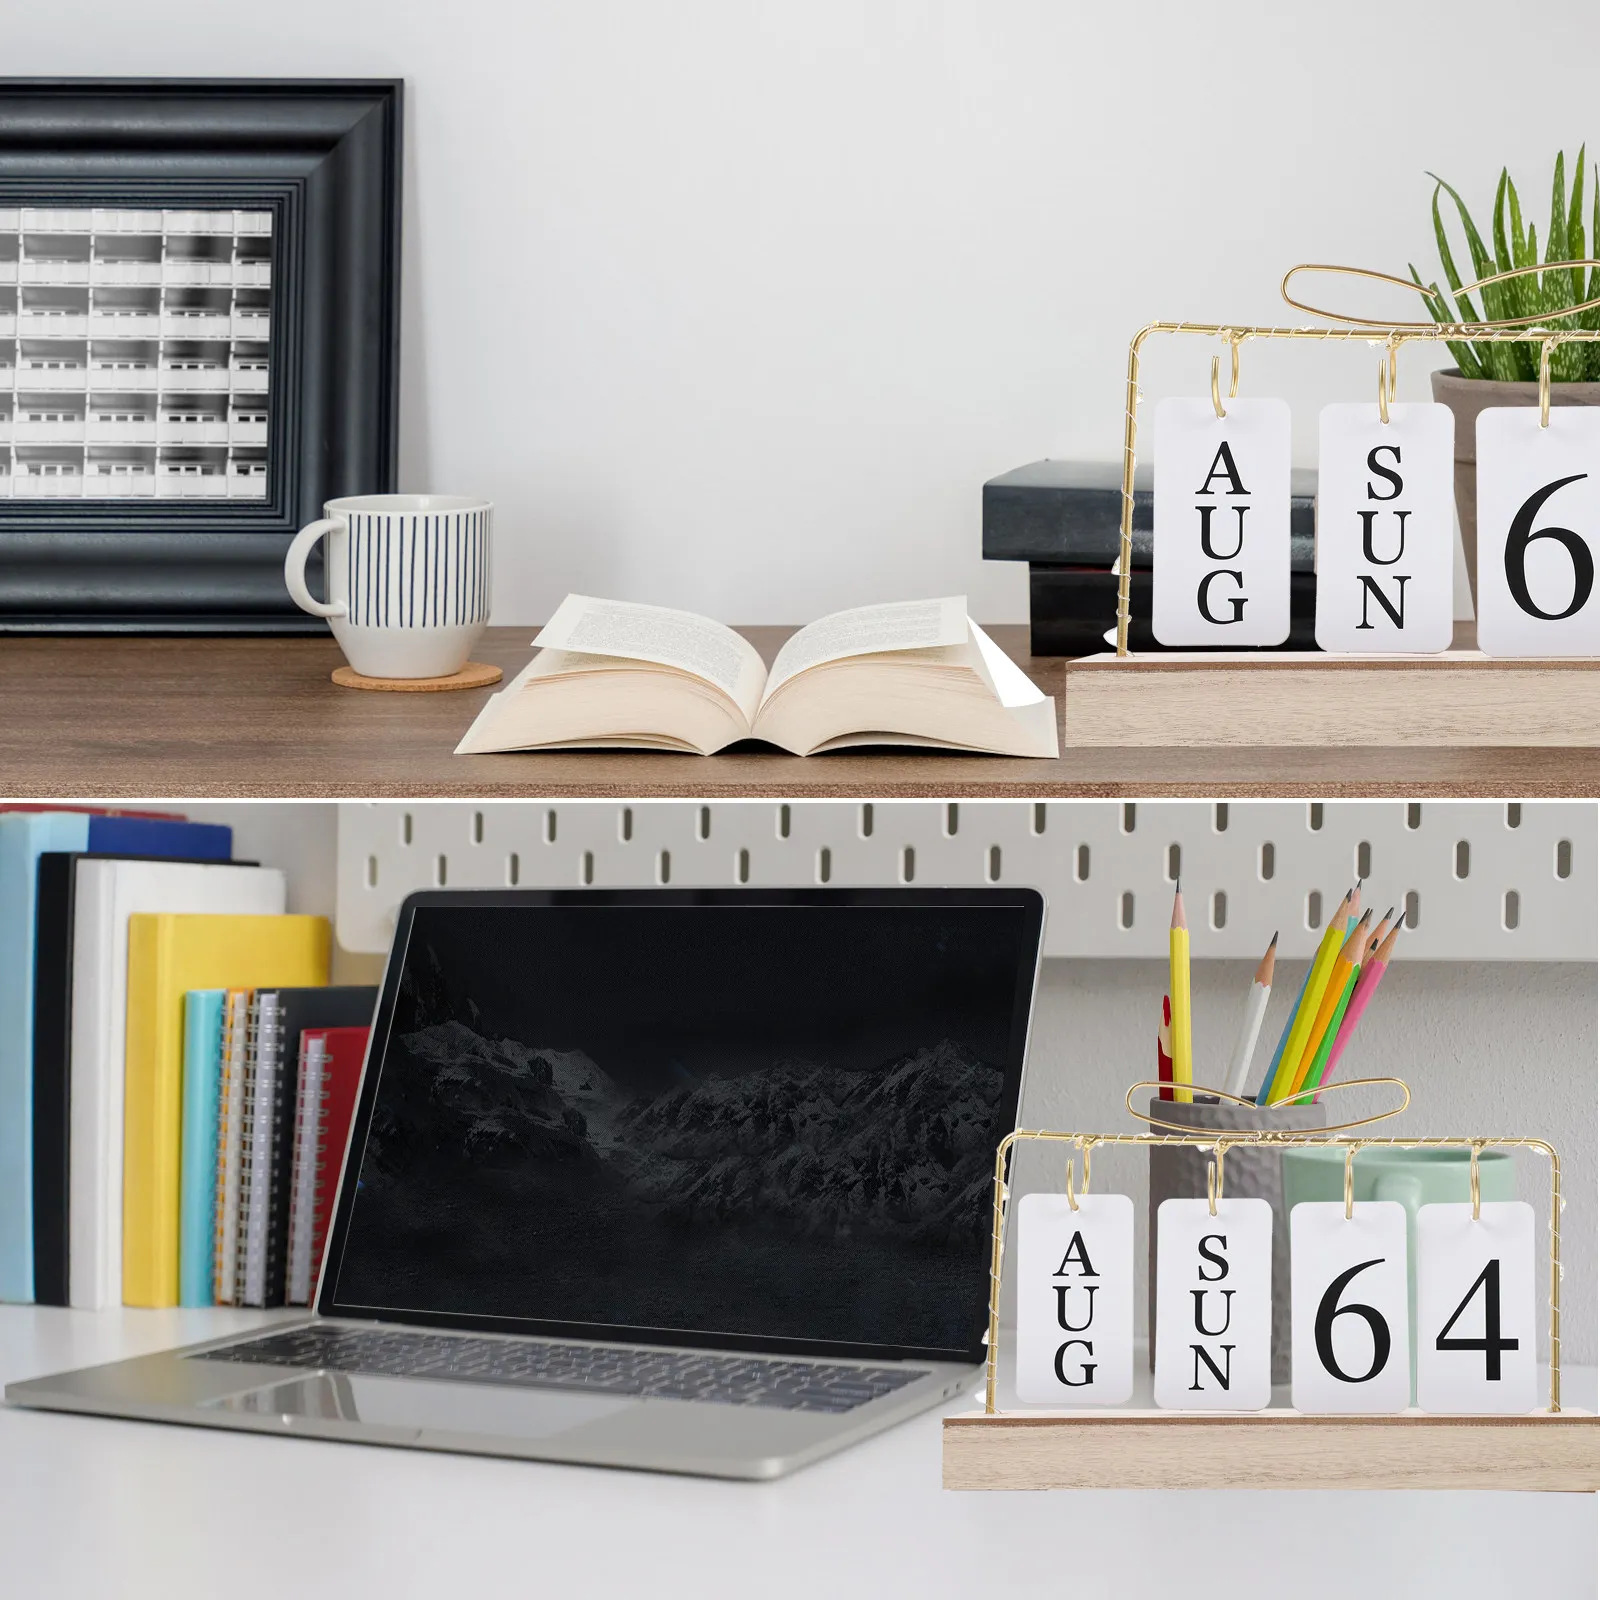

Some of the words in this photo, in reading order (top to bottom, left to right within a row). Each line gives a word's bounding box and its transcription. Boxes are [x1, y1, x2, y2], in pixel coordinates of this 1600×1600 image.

[1194, 440, 1252, 625] AUG
[1355, 445, 1412, 630] SUN
[1504, 473, 1595, 621] 6
[1052, 1230, 1101, 1387] AUG
[1188, 1234, 1237, 1391] SUN
